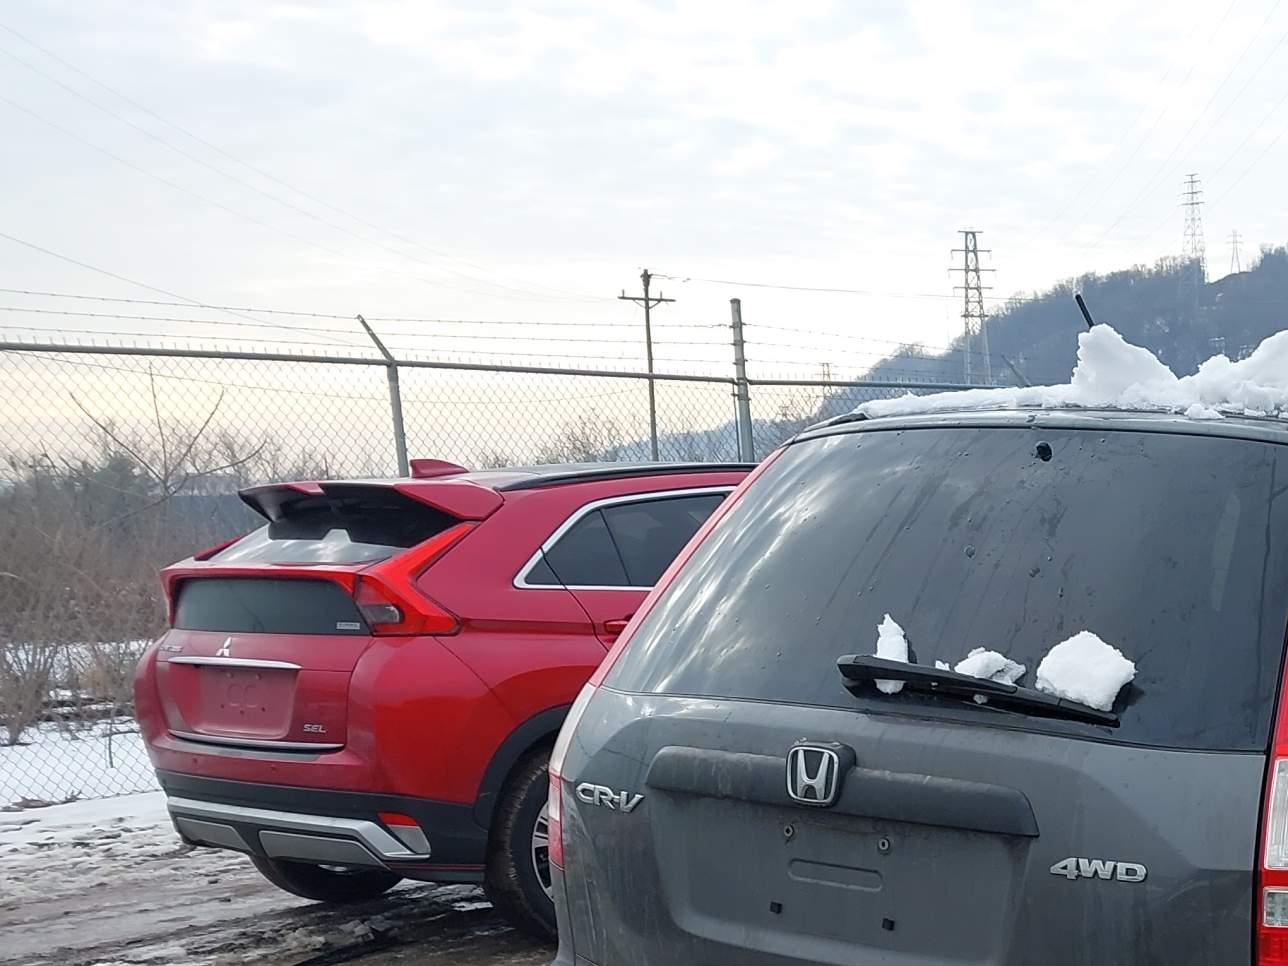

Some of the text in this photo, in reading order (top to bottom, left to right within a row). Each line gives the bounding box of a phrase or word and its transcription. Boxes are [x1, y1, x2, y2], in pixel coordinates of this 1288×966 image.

[303, 723, 327, 733] SEL
[575, 782, 645, 813] CR-V
[1049, 856, 1148, 883] 4WD
